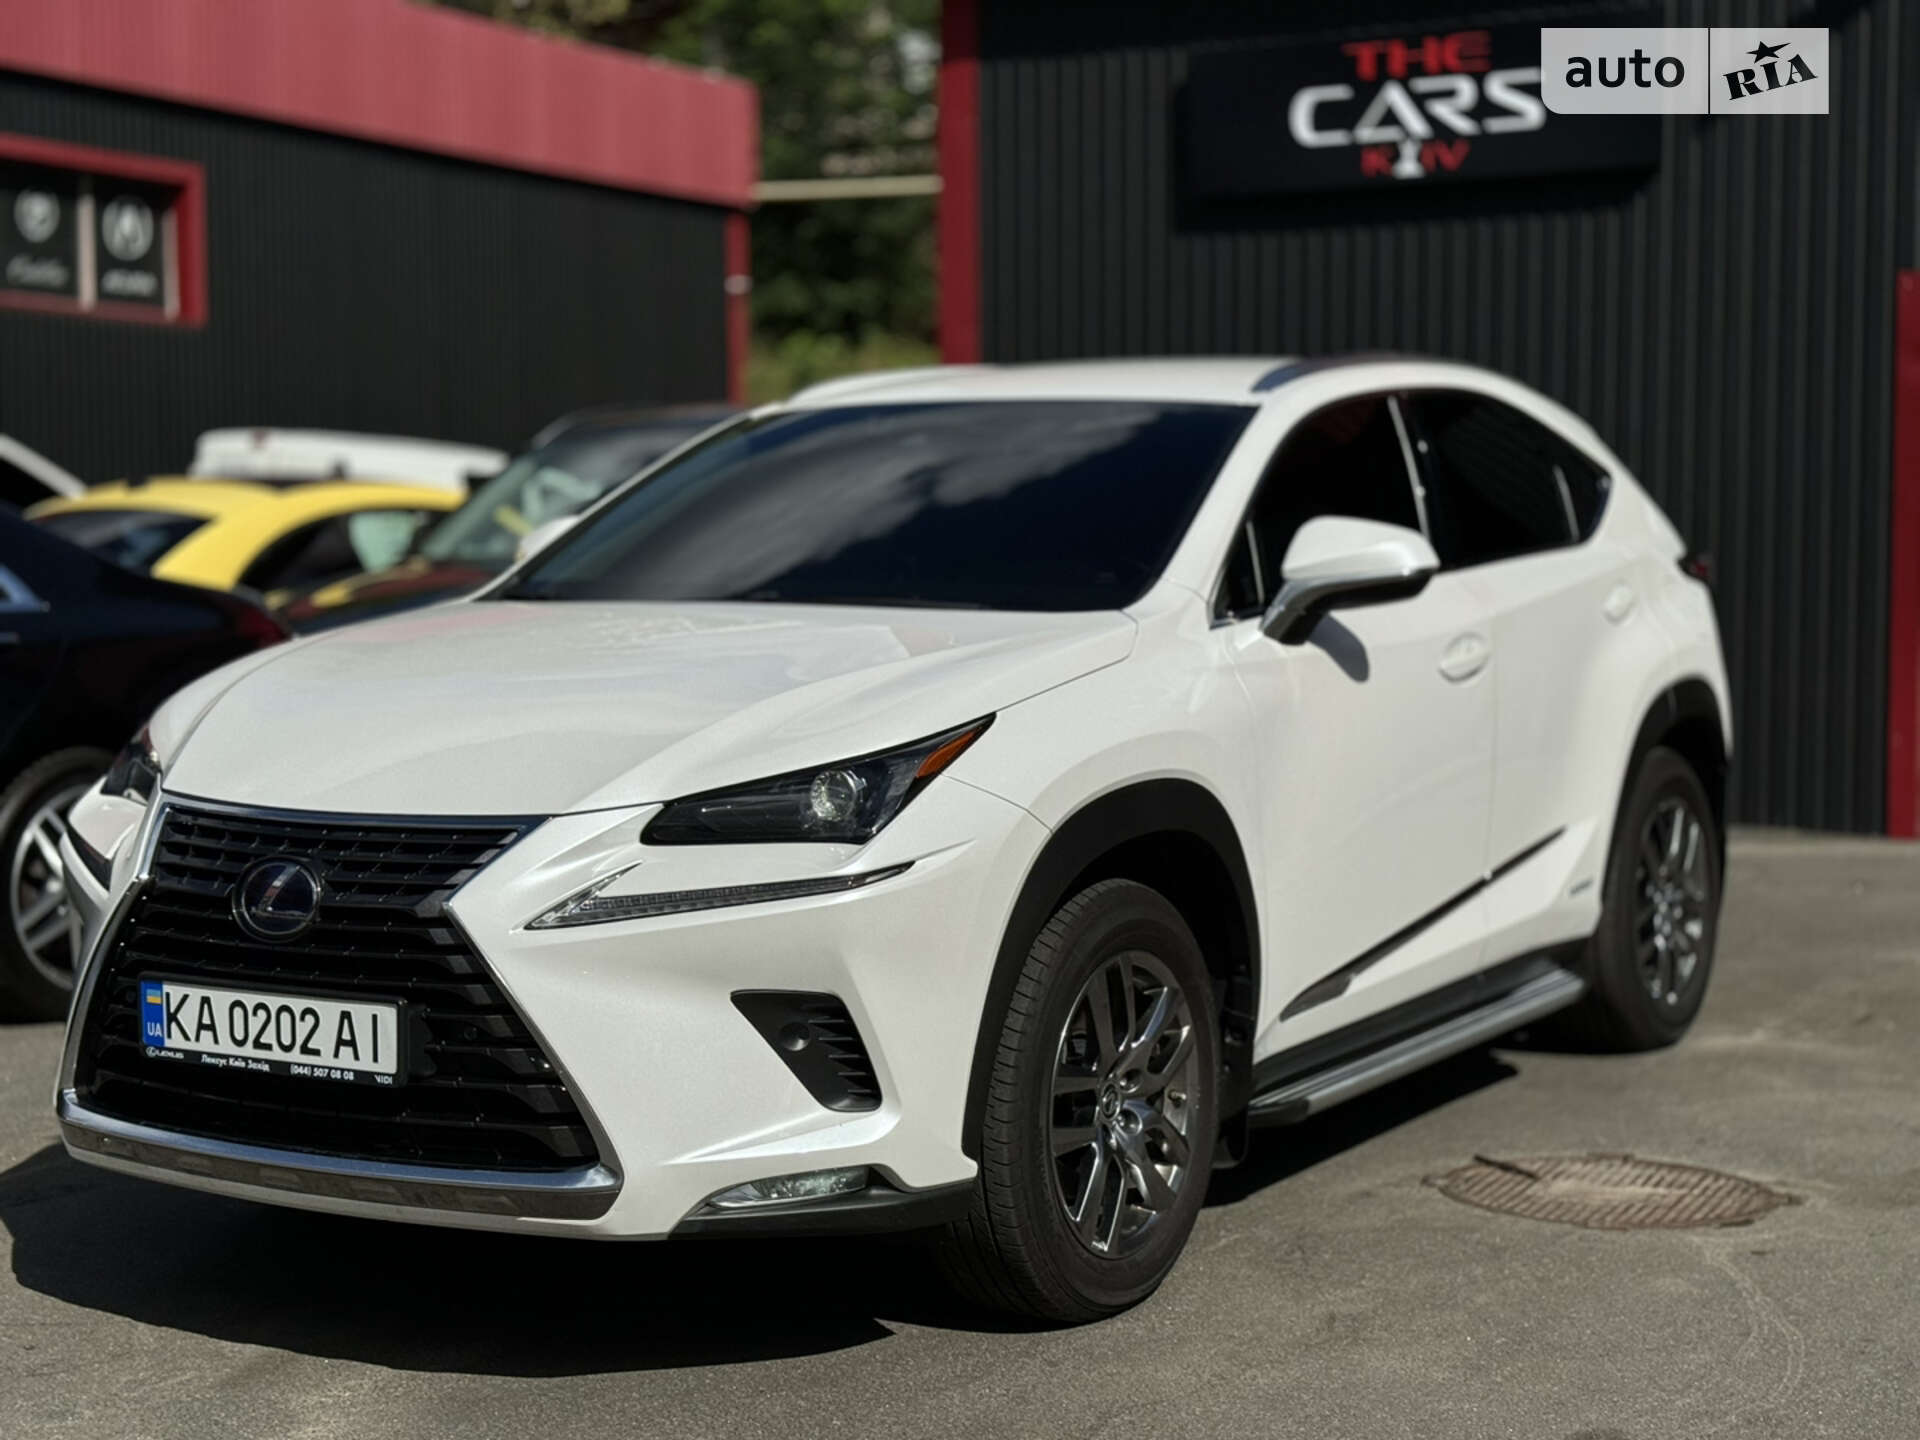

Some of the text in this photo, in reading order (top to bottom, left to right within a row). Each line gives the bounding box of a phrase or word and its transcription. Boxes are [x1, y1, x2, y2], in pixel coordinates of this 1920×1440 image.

[1342, 31, 1492, 81] THE
[1288, 66, 1547, 148] CARS
[147, 1022, 163, 1037] UA
[165, 992, 219, 1045] KA
[228, 1000, 322, 1056] 0202
